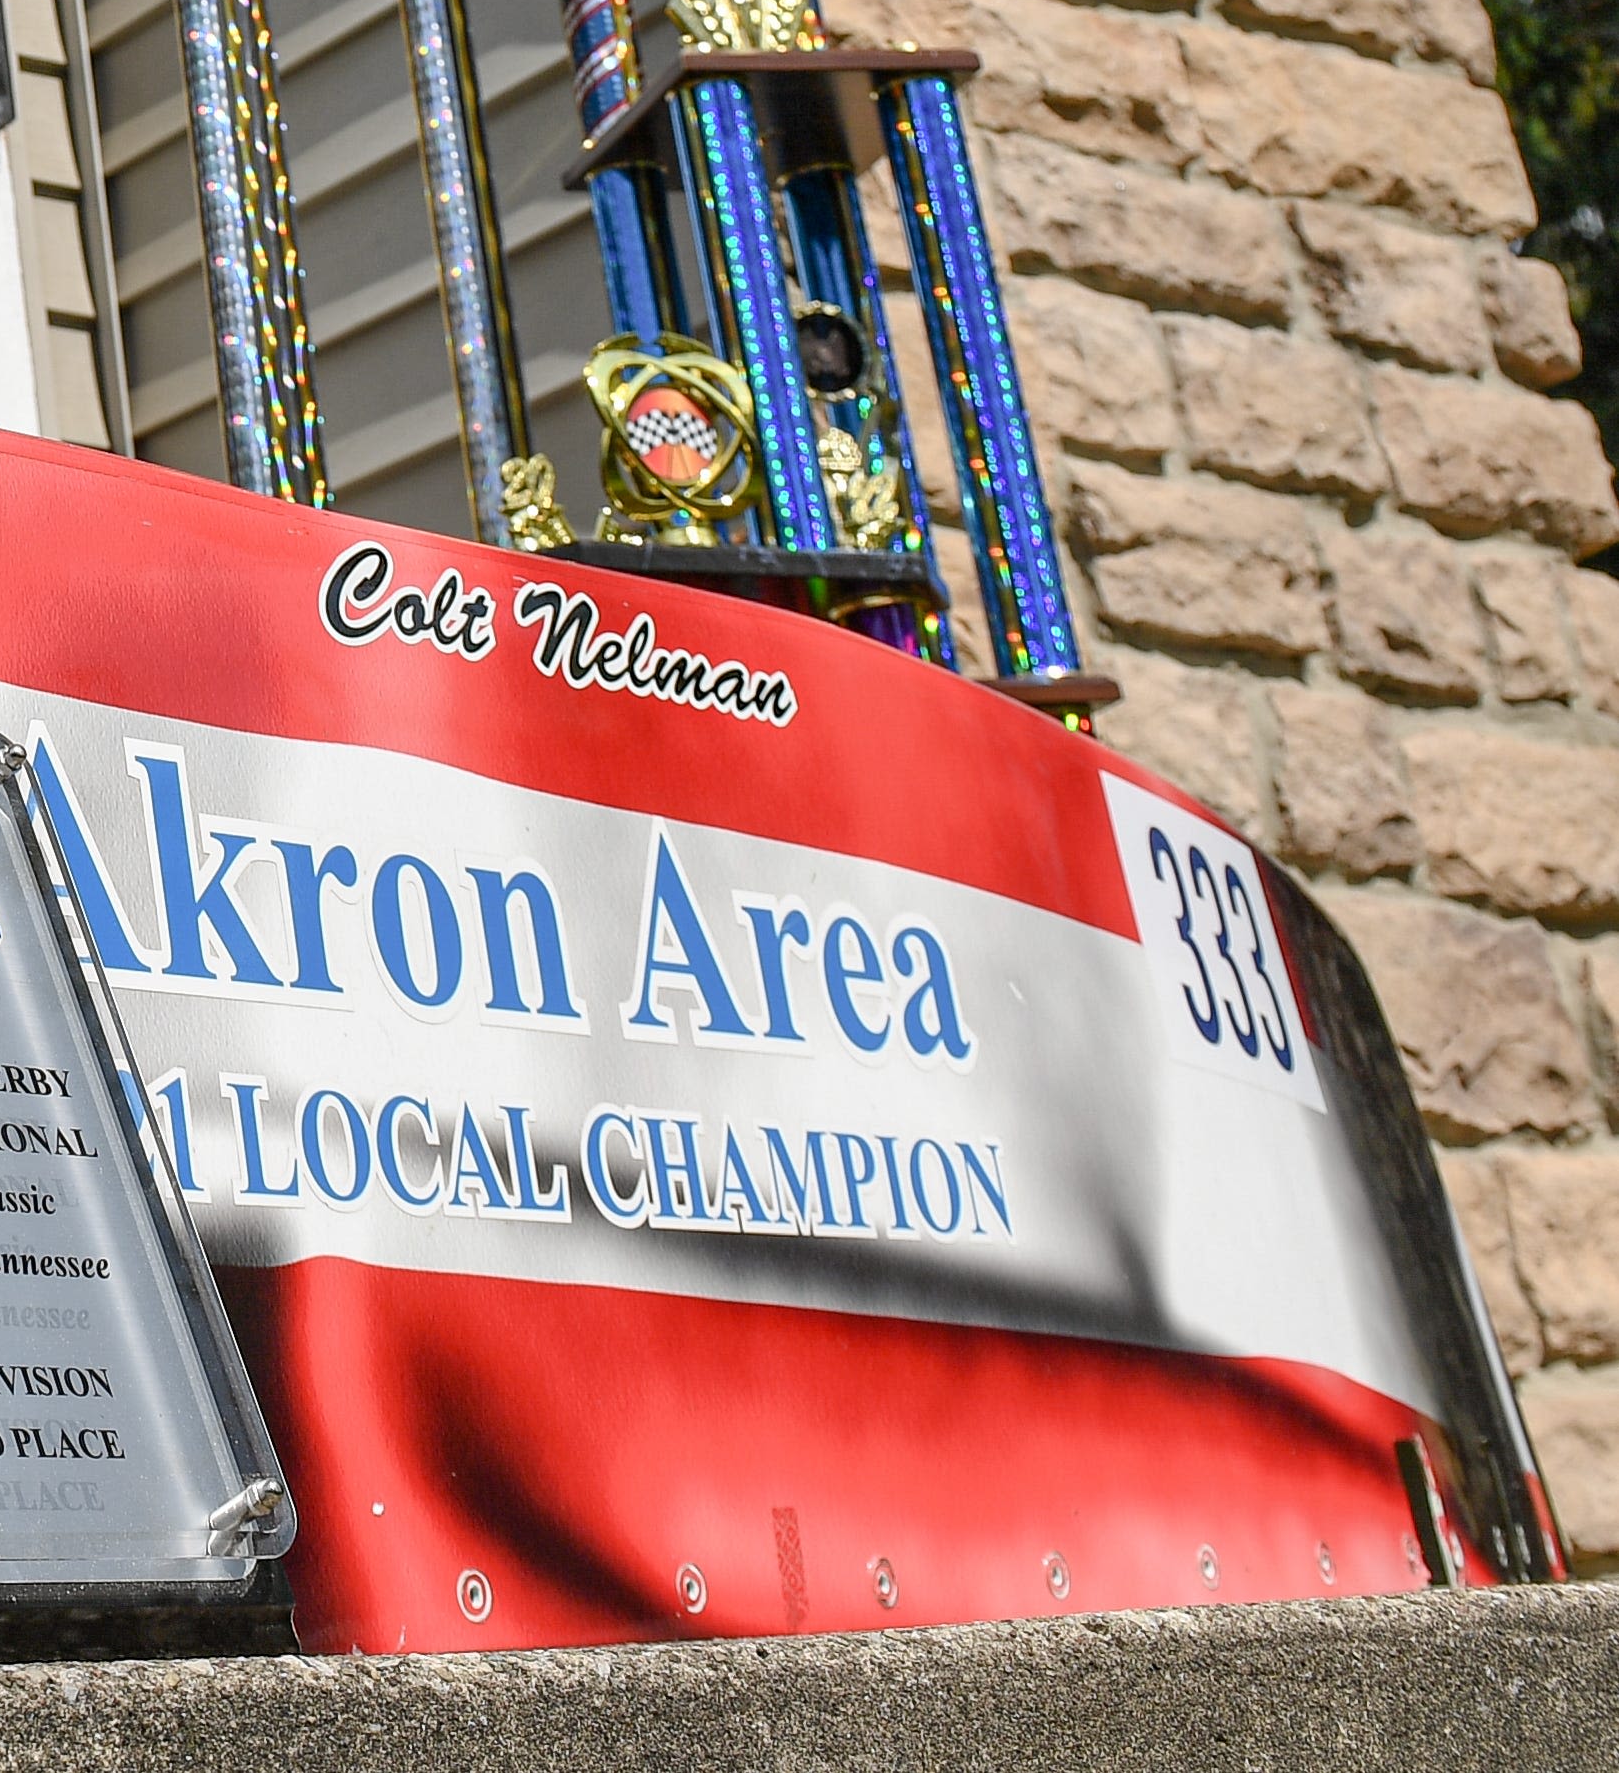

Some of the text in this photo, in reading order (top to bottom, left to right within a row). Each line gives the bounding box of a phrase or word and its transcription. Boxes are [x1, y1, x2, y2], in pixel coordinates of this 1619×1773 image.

[323, 546, 794, 720] Colt Nelman
[26, 737, 971, 1061] Akron Area
[1148, 826, 1294, 1072] 333
[225, 1082, 567, 1213] LOCAL
[587, 1110, 1015, 1238] CHAMPION
[8, 1427, 126, 1460] PLACE
